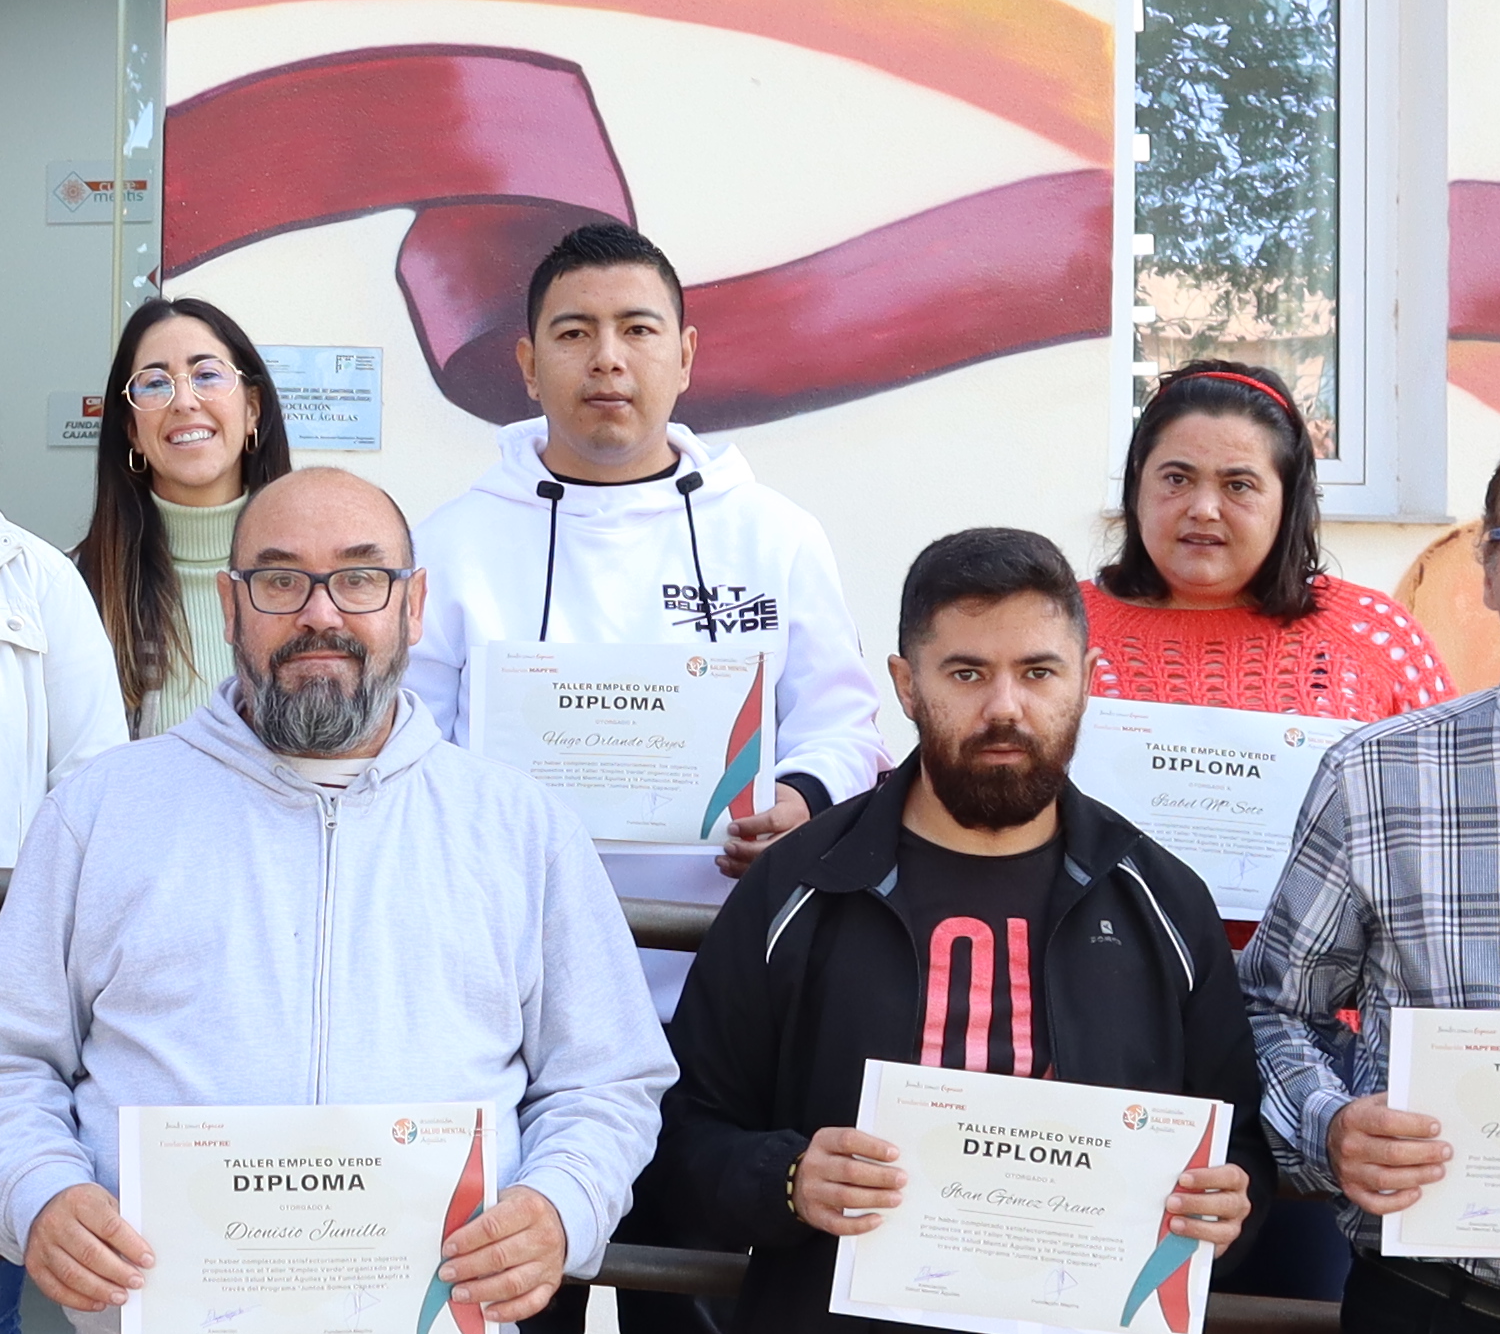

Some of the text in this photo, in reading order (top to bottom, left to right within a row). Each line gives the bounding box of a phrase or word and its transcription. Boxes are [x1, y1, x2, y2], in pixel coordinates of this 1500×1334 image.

[94, 190, 144, 202] metis
[319, 412, 359, 422] ÁGUILAS
[65, 421, 100, 429] FUNDA
[552, 682, 680, 693] TALLER EMPLEO VERDE
[559, 695, 666, 711] DIPLOMA
[1146, 742, 1276, 762] TALLER EMPLEO VERDE
[1152, 756, 1261, 779] DIPLOMA
[930, 1101, 967, 1110] MAPFRE
[956, 1122, 1112, 1148] TALLER EMPLEO VERDE
[963, 1139, 1092, 1169] DIPLOMA
[224, 1157, 382, 1168] TALLER EMPLEO VERDE
[233, 1174, 365, 1192] DIPLOMA
